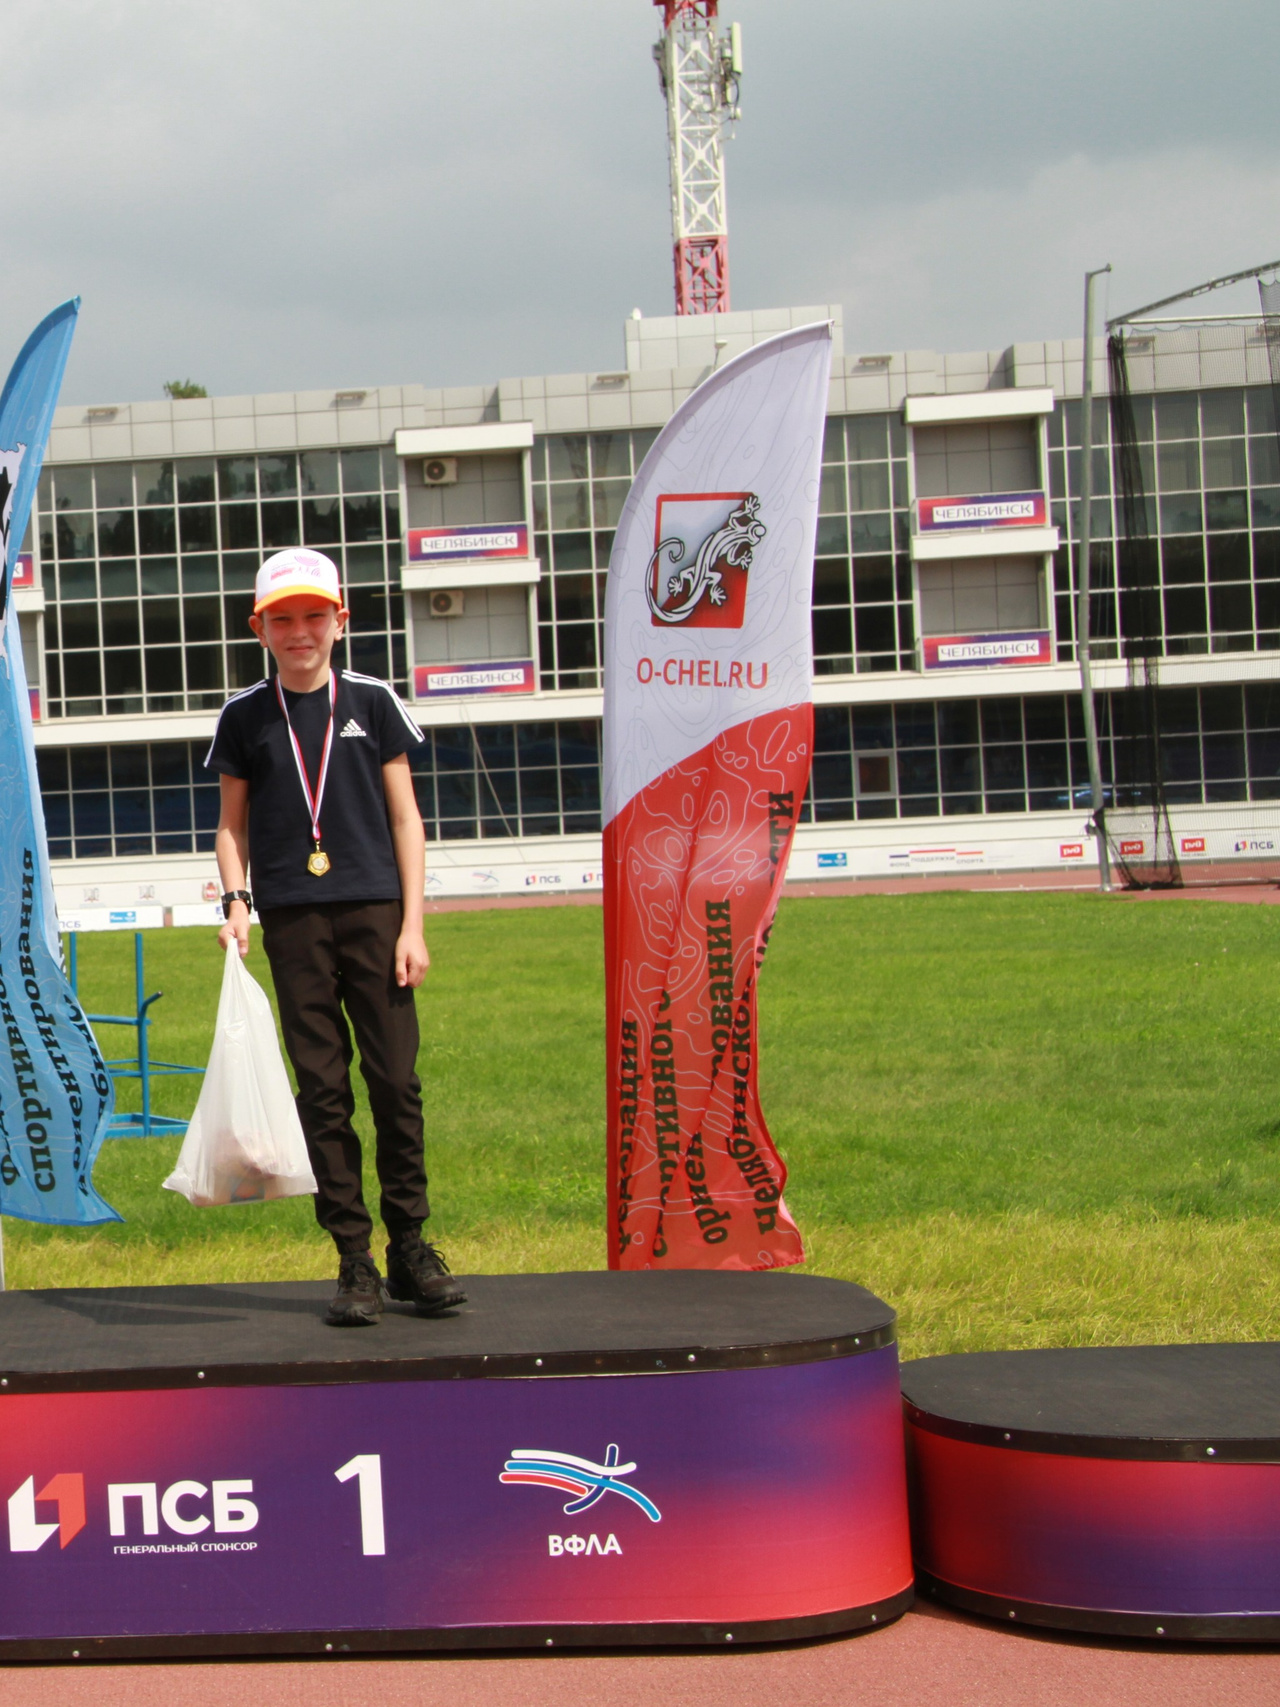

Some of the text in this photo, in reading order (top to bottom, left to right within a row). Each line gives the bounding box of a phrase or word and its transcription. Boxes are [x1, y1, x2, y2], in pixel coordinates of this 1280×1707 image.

[935, 503, 1031, 519] ЧЕЛЯБИНСК
[424, 535, 515, 550] ЧЕЛЯБИНСК
[940, 642, 1036, 658] ЧЕЛЯБИНСК
[430, 671, 521, 686] ЧЕЛЯБИНСК
[636, 657, 768, 690] O-CHEL.RU
[340, 730, 367, 738] adidas
[1249, 840, 1274, 850] ПСБ
[539, 875, 561, 884] ПСБ
[107, 1479, 260, 1537] ПСБ
[333, 1453, 387, 1556] 1
[113, 1541, 258, 1555] ГЕНЕРАЛЬНЫЙ СПОНСОР
[547, 1533, 623, 1557] ВФЛА
